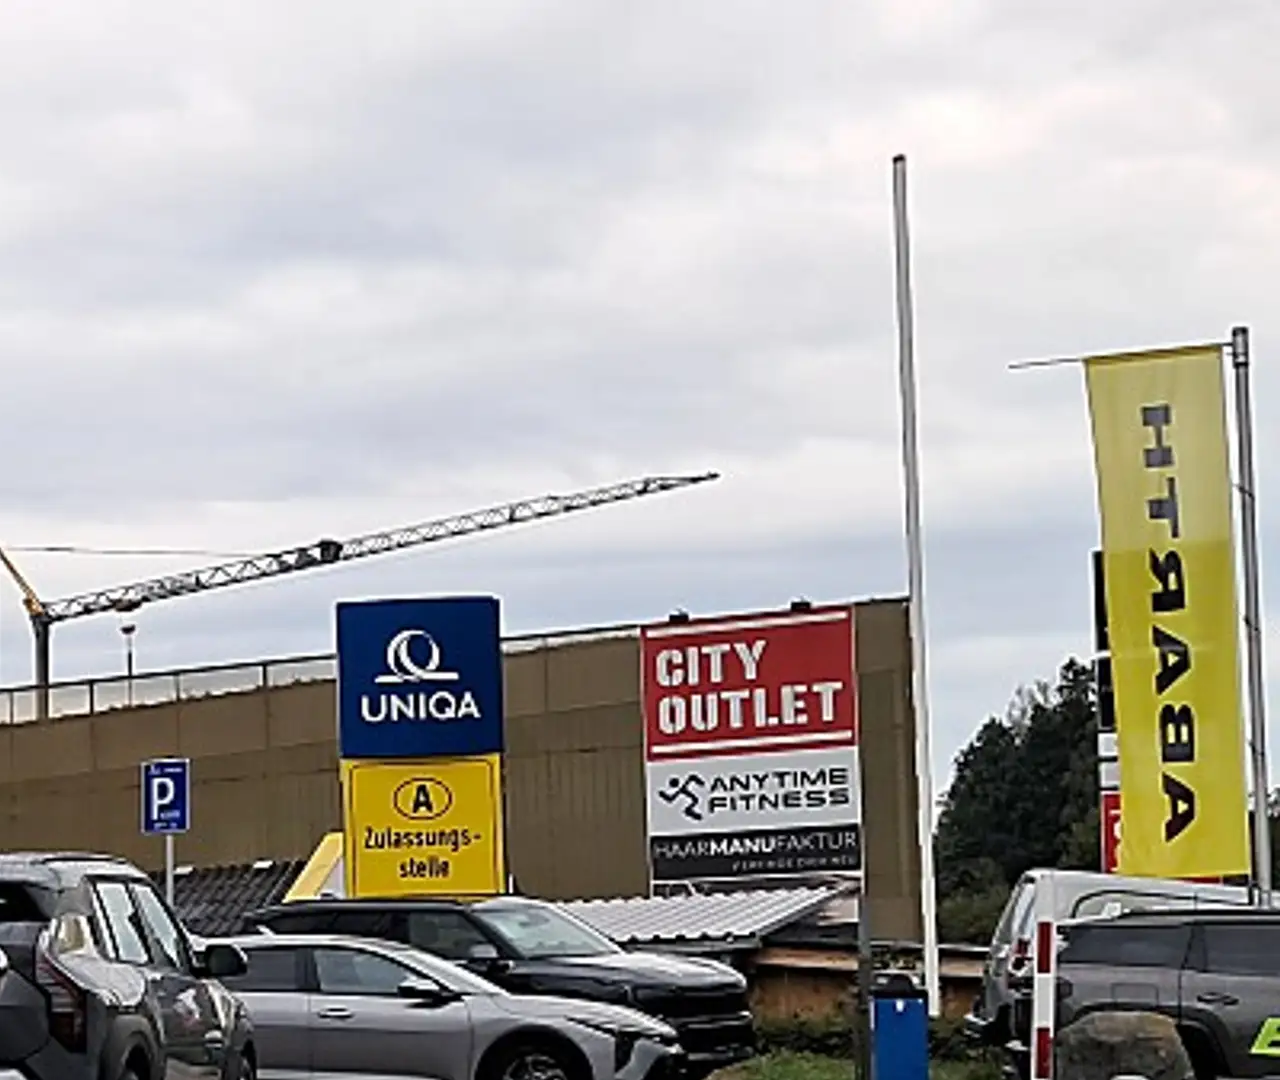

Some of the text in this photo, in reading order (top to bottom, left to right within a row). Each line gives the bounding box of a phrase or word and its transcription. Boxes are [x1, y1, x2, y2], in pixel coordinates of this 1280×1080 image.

[656, 639, 767, 687] CITY
[361, 690, 482, 722] UNIQA
[658, 681, 844, 735] OUTLET
[708, 767, 849, 792] ANYTIME
[151, 777, 175, 821] P
[411, 784, 434, 815] A
[707, 788, 850, 814] FITNESS
[364, 826, 482, 853] Zulassungs-
[653, 831, 858, 859] HAARMANUFAKTUR
[398, 854, 451, 880] stelle
